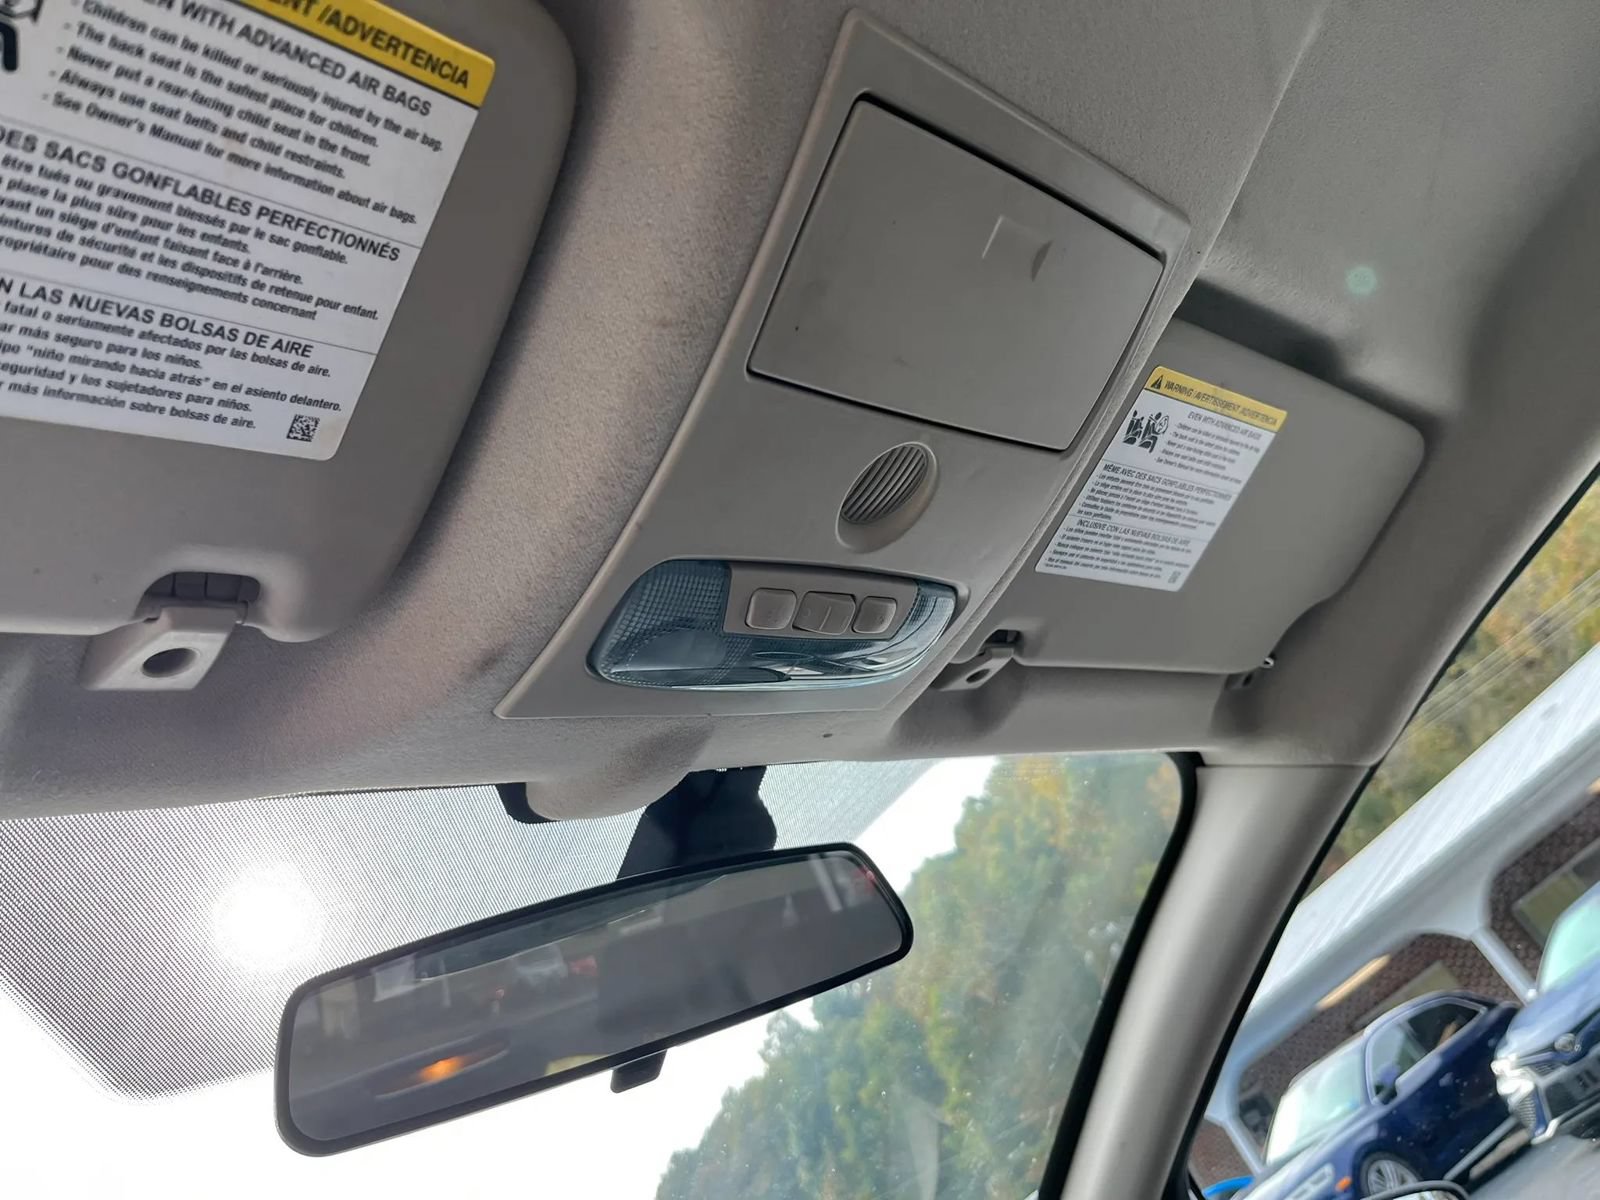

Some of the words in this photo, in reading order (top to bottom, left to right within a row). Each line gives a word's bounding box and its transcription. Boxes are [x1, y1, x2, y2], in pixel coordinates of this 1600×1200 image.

[77, 22, 106, 46] The
[108, 35, 146, 60] back
[149, 52, 182, 73] seat
[183, 62, 198, 80] is
[200, 69, 225, 89] the
[226, 81, 270, 105] safest
[269, 98, 307, 119] place
[307, 110, 328, 127] for
[328, 121, 378, 148] children.
[150, 27, 179, 47] can
[180, 36, 200, 55] be
[202, 45, 243, 71] killed
[243, 63, 260, 77] or
[261, 71, 320, 104] seriously
[322, 92, 366, 120] injured
[366, 110, 382, 128] by
[383, 118, 403, 135] the
[404, 128, 420, 141] air
[420, 133, 443, 153] bag.
[181, 2, 237, 35] WITH
[237, 25, 346, 80] ADVANCED
[347, 71, 381, 96] AIR
[383, 85, 432, 117] BAGS
[60, 70, 116, 100] Always
[119, 92, 146, 110] use
[150, 102, 182, 121] seat
[184, 112, 218, 134] belts
[221, 127, 248, 145] and
[250, 137, 283, 157] child
[285, 150, 344, 179] restraints.
[67, 45, 113, 72] Never
[114, 65, 143, 84] put
[158, 81, 235, 119] rear-facing
[237, 109, 272, 130] child
[272, 122, 302, 141] seat
[302, 131, 317, 146] in
[318, 137, 339, 155] the
[340, 145, 371, 167] front.
[53, 92, 83, 114] See
[86, 103, 146, 134] Owner's
[150, 124, 203, 152] Manual
[204, 142, 225, 159] for
[227, 152, 262, 172] more
[264, 163, 335, 197] information
[337, 190, 372, 209] about
[372, 202, 388, 214] air
[389, 206, 416, 225] bags.
[4, 155, 34, 175] être
[38, 165, 72, 186] tués
[75, 177, 95, 192] ou
[97, 184, 174, 214] gravement
[176, 205, 227, 230] blessés
[228, 222, 252, 236] par
[254, 227, 267, 241] le
[269, 234, 291, 248] sac
[292, 242, 347, 264] gonflable.
[7, 179, 50, 200] place
[53, 188, 68, 205] la
[70, 196, 103, 214] plus
[140, 215, 174, 232] pour
[176, 223, 197, 240] les
[200, 232, 249, 254] enfants.
[35, 206, 56, 220] un
[58, 212, 99, 232] siège
[163, 238, 211, 260] faisant
[212, 251, 241, 268] face
[44, 141, 107, 174] SACS
[113, 162, 252, 216] GONFLABLES
[256, 206, 400, 261] PERFECTIONNÉS
[56, 229, 75, 244] de
[79, 236, 138, 259] sécurité
[140, 252, 156, 264] et
[157, 254, 178, 270] les
[182, 262, 248, 288] dispositifs
[251, 279, 267, 292] de
[269, 286, 314, 304] retenue
[315, 297, 342, 311] pour
[343, 305, 378, 321] enfant.
[80, 255, 114, 272] pour
[117, 263, 143, 279] des
[147, 272, 249, 304] renseignements
[252, 298, 318, 321] concernant
[5, 301, 40, 319] fatal
[56, 314, 135, 338] seriamente
[204, 345, 228, 357] por
[229, 347, 249, 361] las
[250, 352, 289, 369] bolsas
[291, 361, 306, 373] de
[307, 365, 331, 378] aire.
[19, 282, 64, 306] LAS
[69, 294, 155, 324] NUEVAS
[159, 313, 240, 343] BOLSAS
[243, 332, 271, 349] DE
[271, 339, 314, 359] AIRE
[19, 326, 51, 341] más
[54, 333, 104, 351] seguro
[106, 343, 139, 357] para
[141, 348, 162, 362] los
[164, 354, 203, 370] niños.
[9, 383, 40, 396] más
[43, 387, 126, 409] información
[130, 402, 167, 415] sobre
[170, 406, 211, 422] bolsas
[213, 414, 229, 425] de
[231, 417, 256, 429] aire.
[69, 355, 127, 373] mirando
[129, 364, 167, 381] hacia
[212, 381, 229, 392] en
[230, 384, 244, 394] el
[245, 388, 288, 402] asiento
[290, 394, 342, 412] delantero.
[81, 374, 103, 388] los
[106, 380, 183, 401] sujetadores
[185, 394, 215, 406] para
[217, 399, 252, 413] niños.
[1164, 380, 1194, 397] WARNING
[1077, 519, 1107, 530] INCLUSIVE
